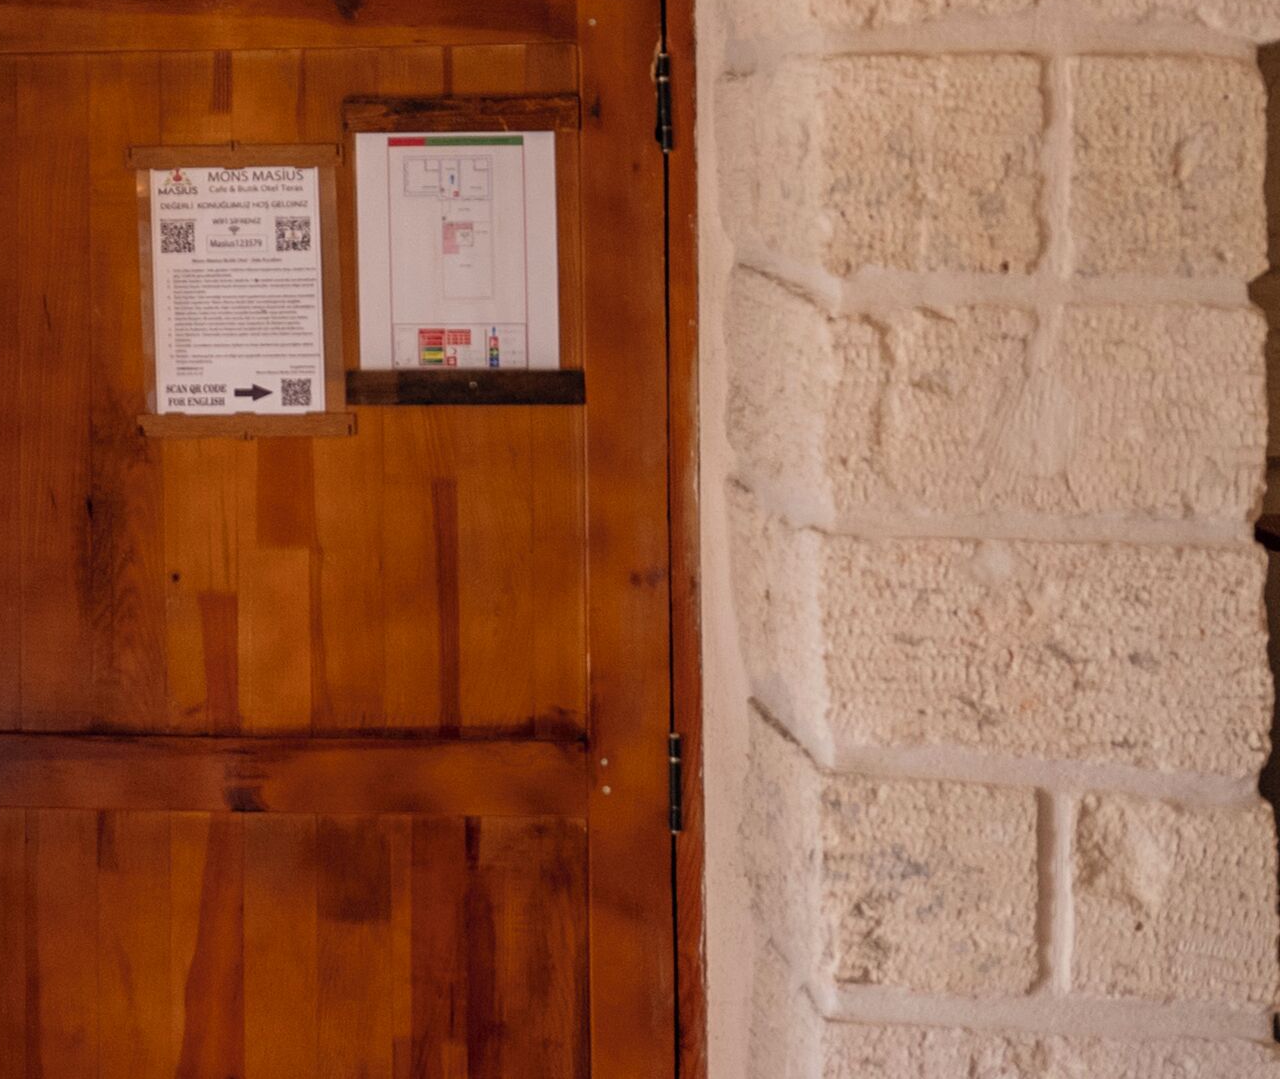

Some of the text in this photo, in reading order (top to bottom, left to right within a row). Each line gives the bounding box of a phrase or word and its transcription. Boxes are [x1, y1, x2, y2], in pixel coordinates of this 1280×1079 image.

[208, 171, 248, 182] MONS
[166, 384, 187, 394] SCAN
[203, 383, 227, 393] CODE
[168, 396, 225, 406] FOR ENGLISH
